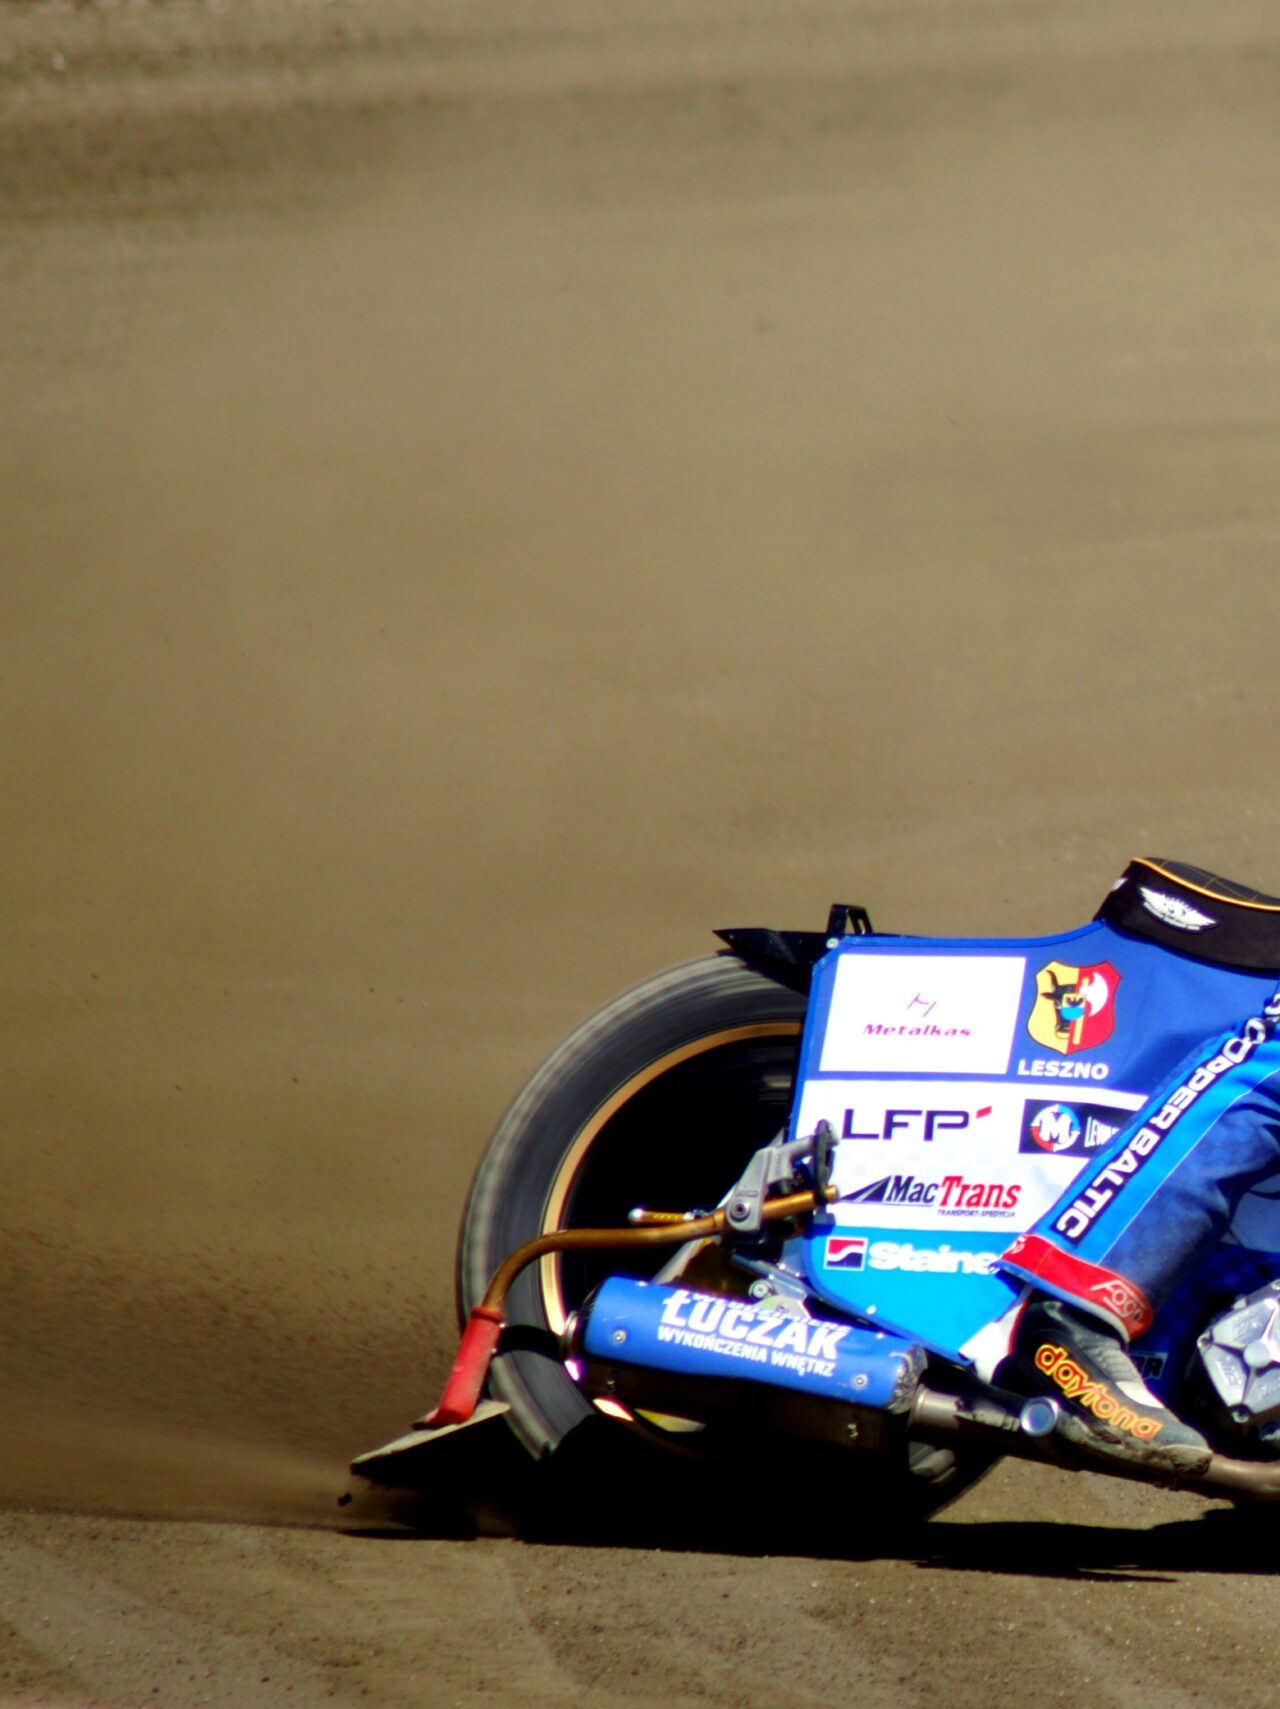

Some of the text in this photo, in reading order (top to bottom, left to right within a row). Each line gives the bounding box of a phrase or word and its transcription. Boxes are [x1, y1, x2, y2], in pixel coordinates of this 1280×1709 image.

[862, 1023, 972, 1038] Metalkas
[1017, 1059, 1109, 1080] LESZNO
[1056, 1132, 1160, 1238] BALTIC
[657, 1325, 837, 1377] WYKOŃCZENIA WNĘTRZ
[661, 1289, 849, 1361] ŁUCZAK
[1035, 1343, 1163, 1440] daytona
